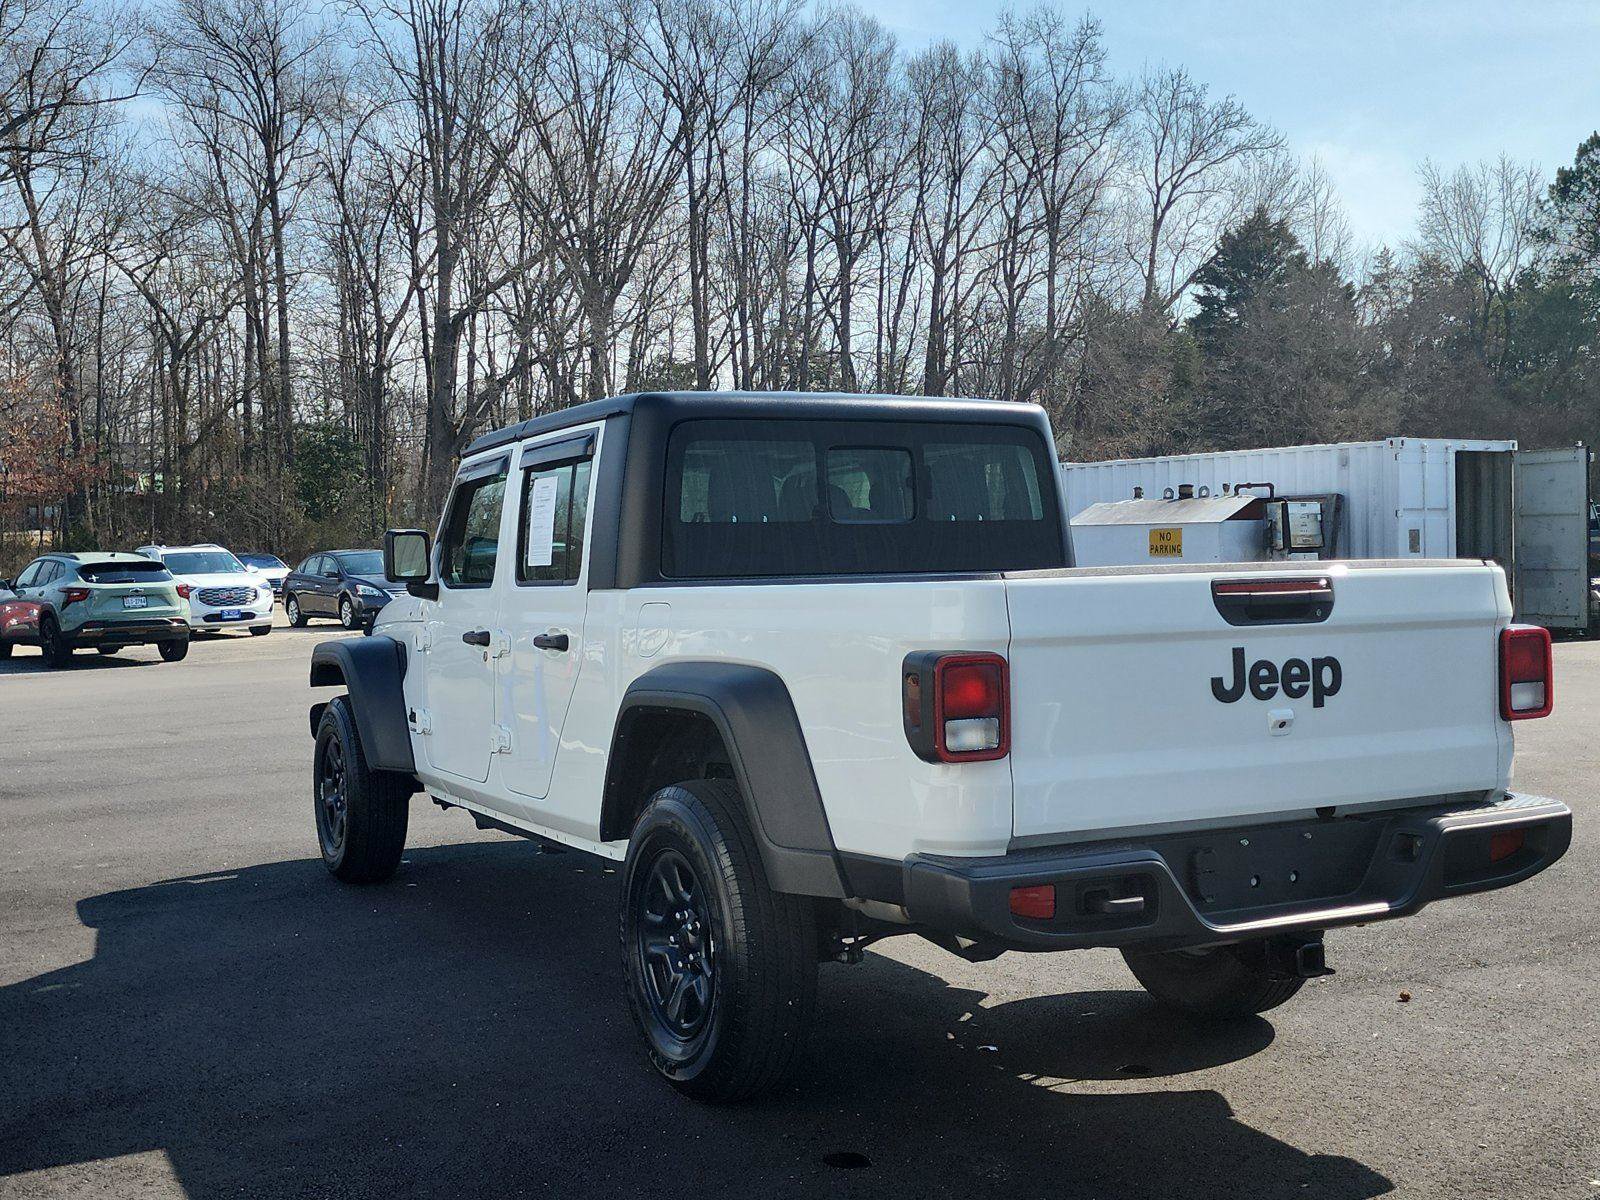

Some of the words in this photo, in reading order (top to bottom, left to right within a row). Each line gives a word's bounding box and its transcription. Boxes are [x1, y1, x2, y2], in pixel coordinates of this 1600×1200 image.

[1159, 531, 1171, 541] NO
[1150, 544, 1182, 554] PARKING
[1211, 647, 1342, 708] Jeep
